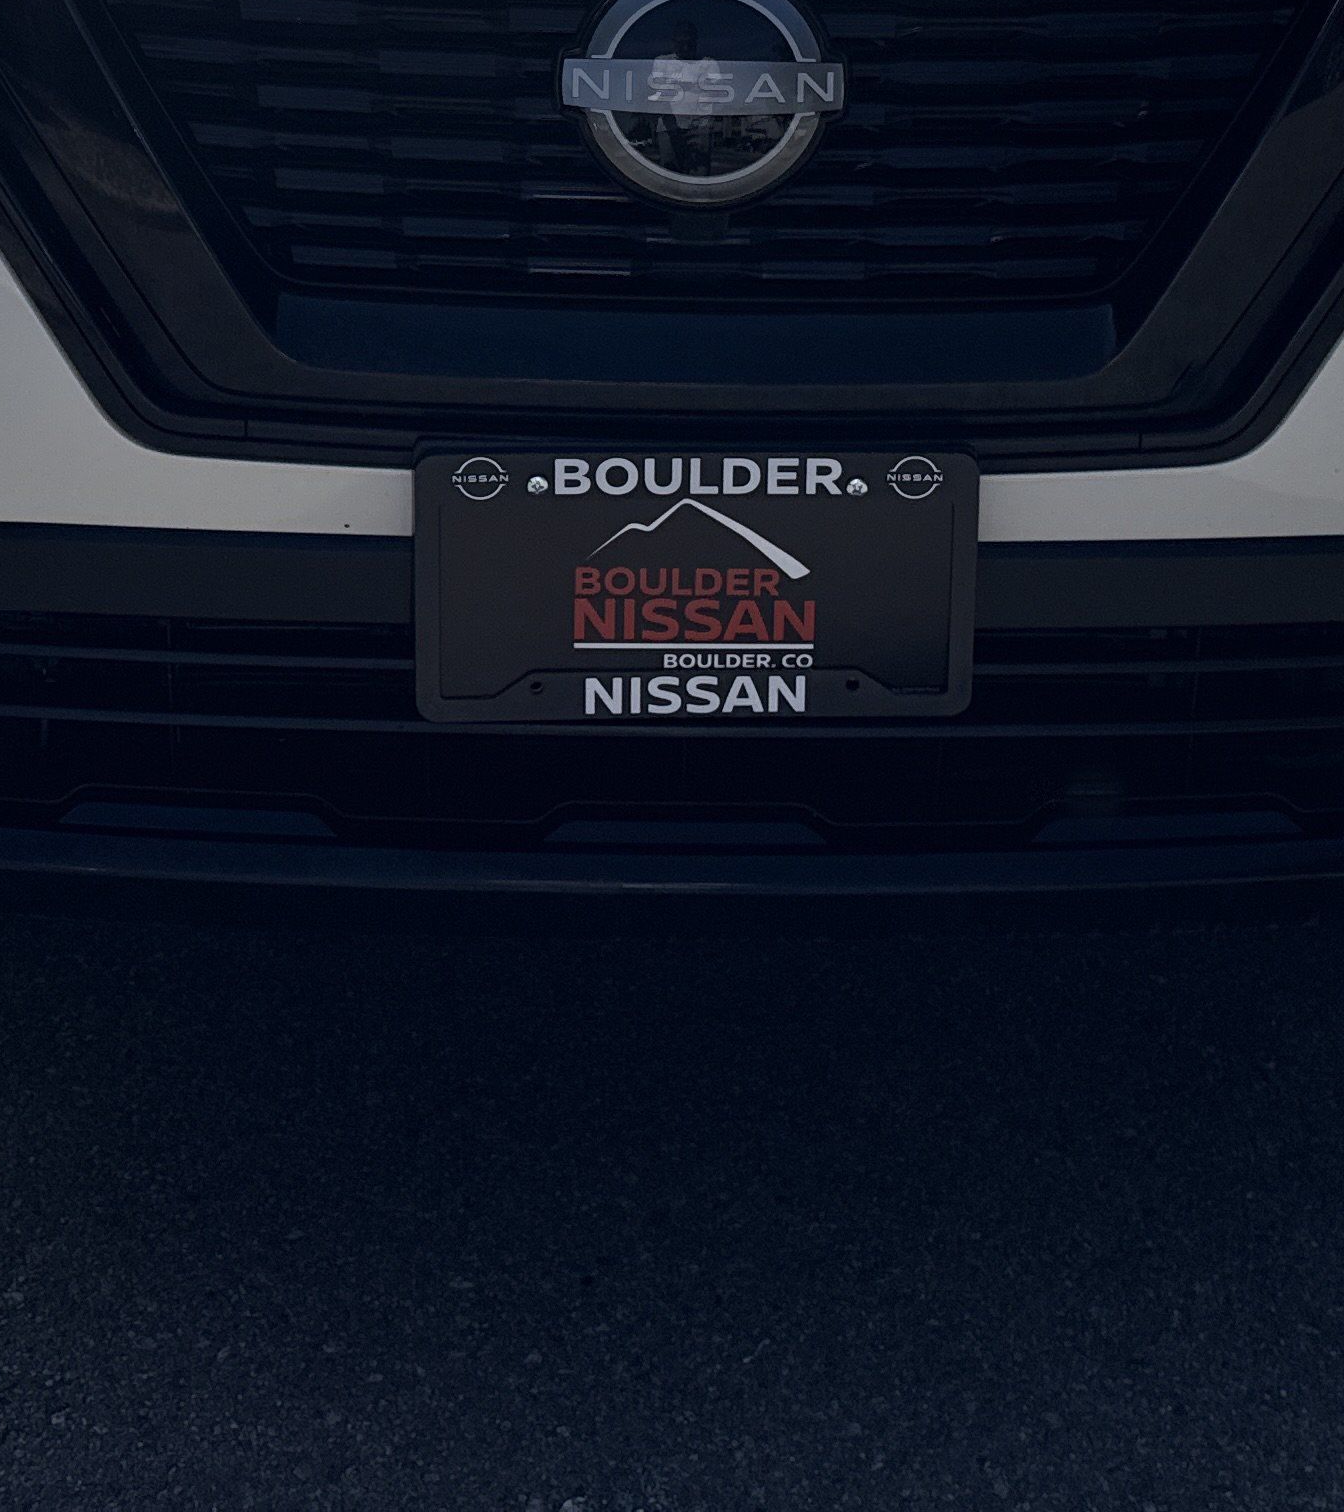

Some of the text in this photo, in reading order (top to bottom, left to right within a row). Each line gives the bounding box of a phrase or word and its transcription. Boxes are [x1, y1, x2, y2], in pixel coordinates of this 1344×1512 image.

[572, 68, 835, 103] NISSAN
[451, 474, 509, 483] NISSAN
[554, 458, 843, 495] BOULDER
[887, 473, 943, 482] NISSAN
[574, 566, 780, 595] BOULDER
[573, 598, 816, 641] NISSAN
[782, 653, 814, 669] CO
[585, 675, 807, 715] NISSAN
